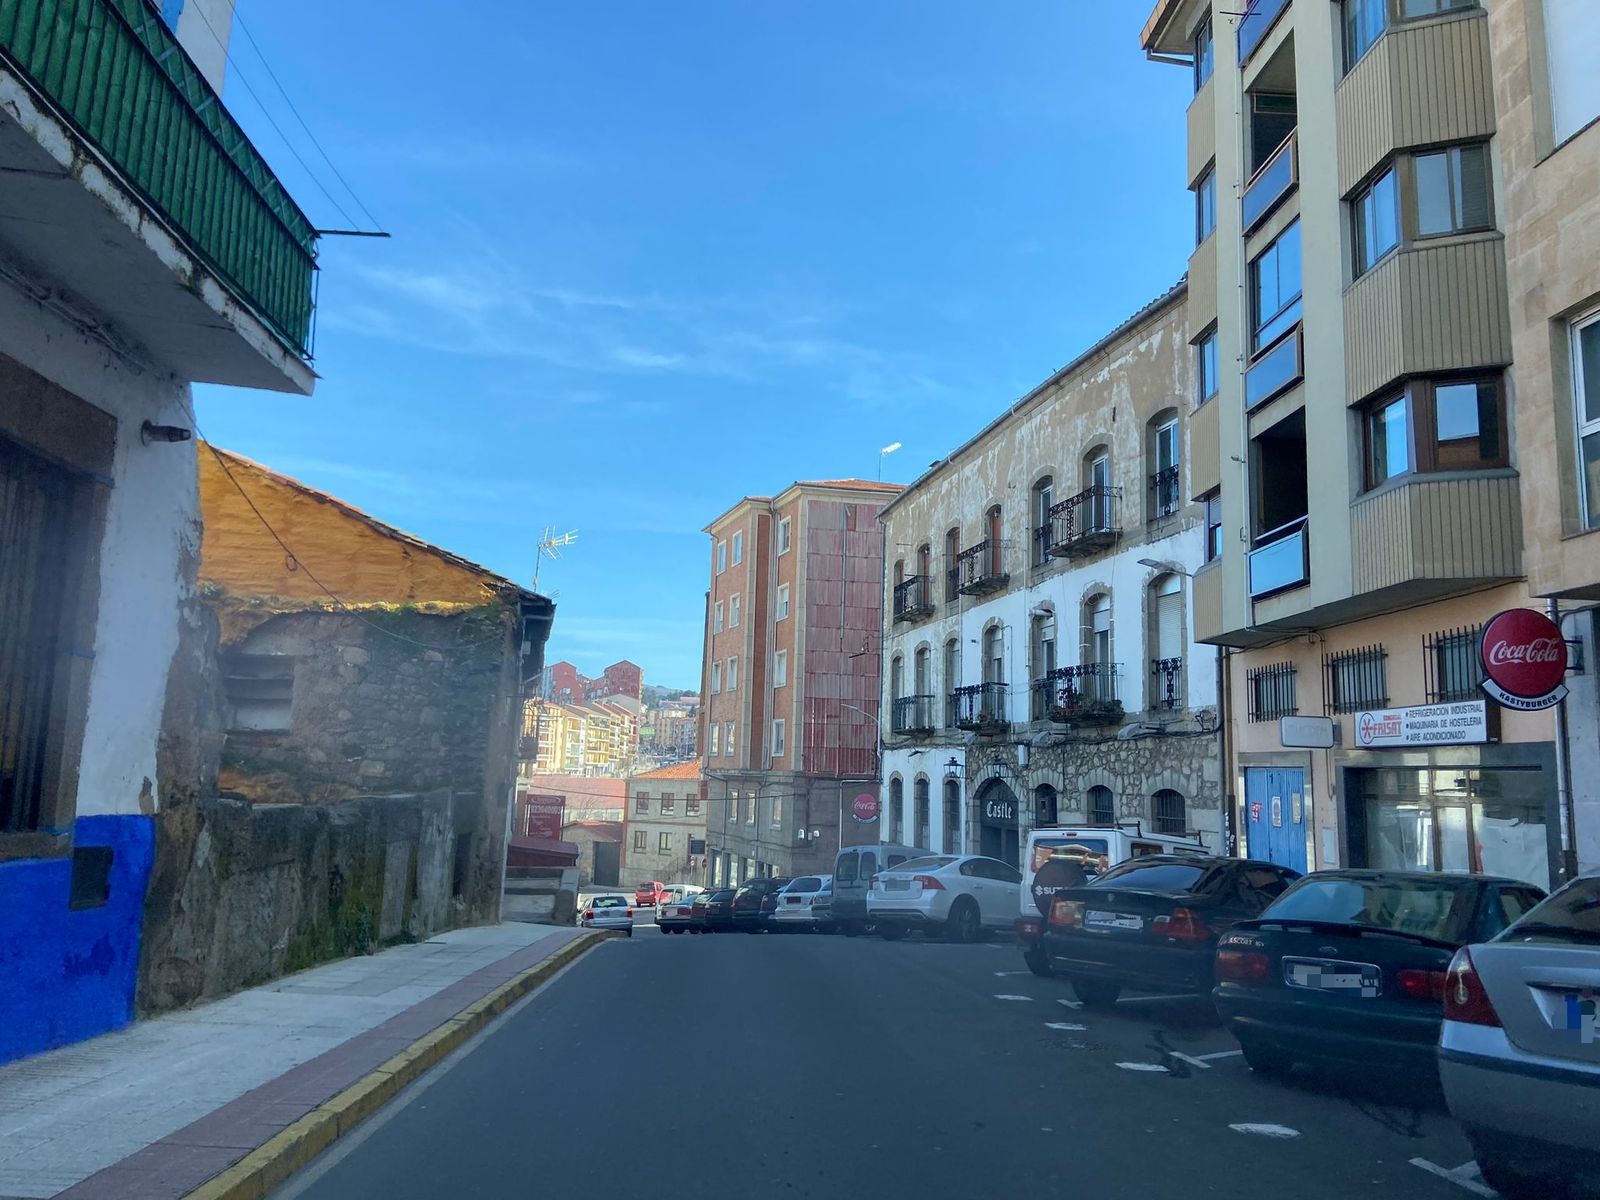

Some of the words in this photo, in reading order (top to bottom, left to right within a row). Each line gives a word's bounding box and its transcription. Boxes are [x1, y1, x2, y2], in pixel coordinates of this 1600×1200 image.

[1489, 638, 1559, 665] Coca-Cola
[1499, 692, 1558, 708] KASTYBURGER
[1450, 703, 1483, 715] INDUSTRIAL
[1409, 719, 1439, 729] MAQUINARIA
[1440, 719, 1448, 728] DE
[1409, 732, 1421, 741] AIRE
[1422, 730, 1466, 740] ACONDICIONADO
[986, 800, 1012, 819] Castle
